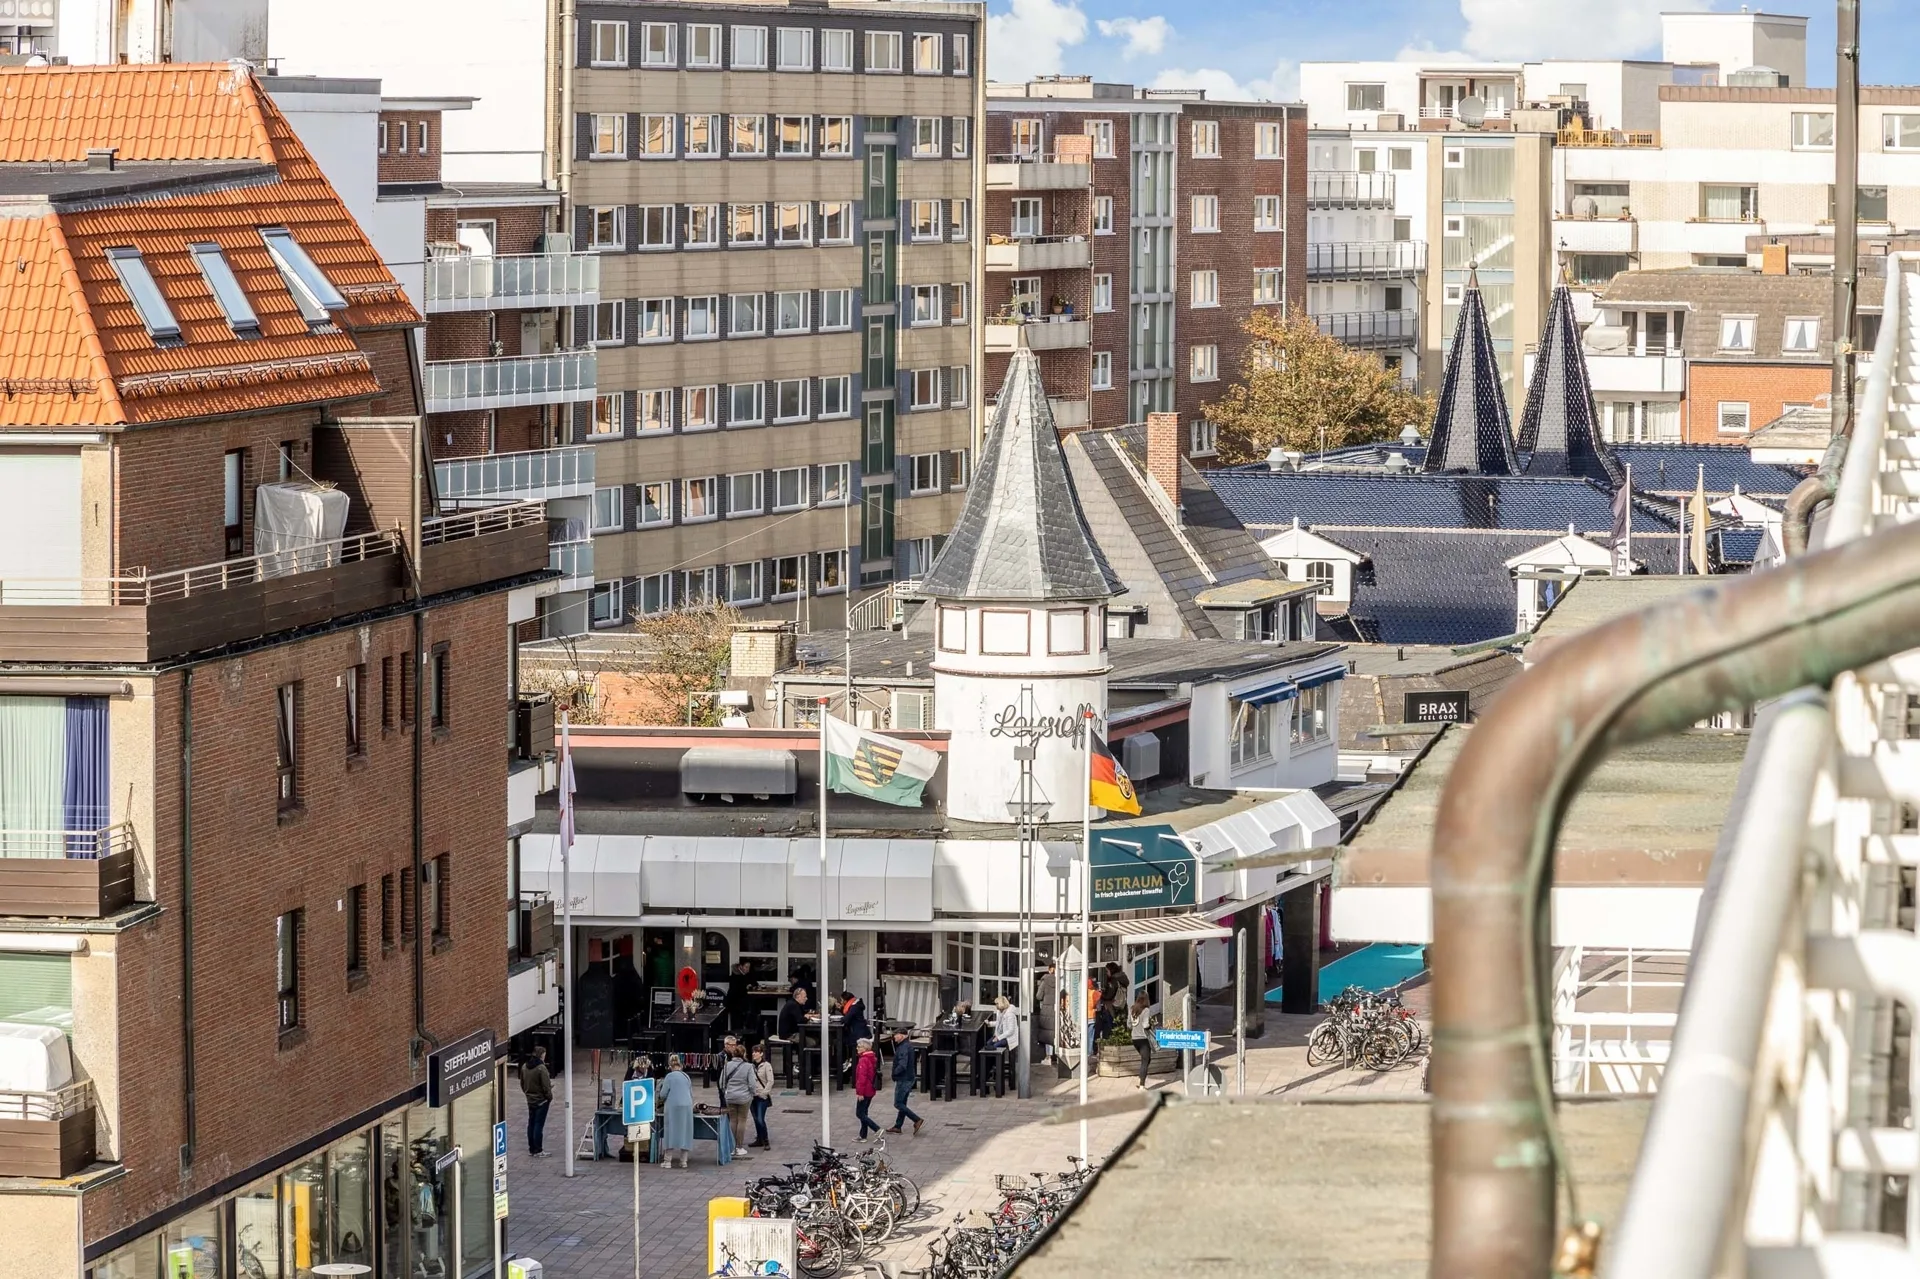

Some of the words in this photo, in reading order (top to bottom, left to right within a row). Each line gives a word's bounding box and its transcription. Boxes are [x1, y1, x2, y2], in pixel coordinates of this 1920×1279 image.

[1419, 702, 1457, 714] BRAX
[1095, 875, 1163, 891] EISTRAUM
[1114, 889, 1141, 898] gebackener
[1160, 1032, 1201, 1040] Friedrichstraße
[444, 1040, 492, 1073] STEFFI-MODEN
[461, 1069, 487, 1089] GÜLCHER
[631, 1085, 647, 1118] P
[496, 1127, 504, 1153] P
